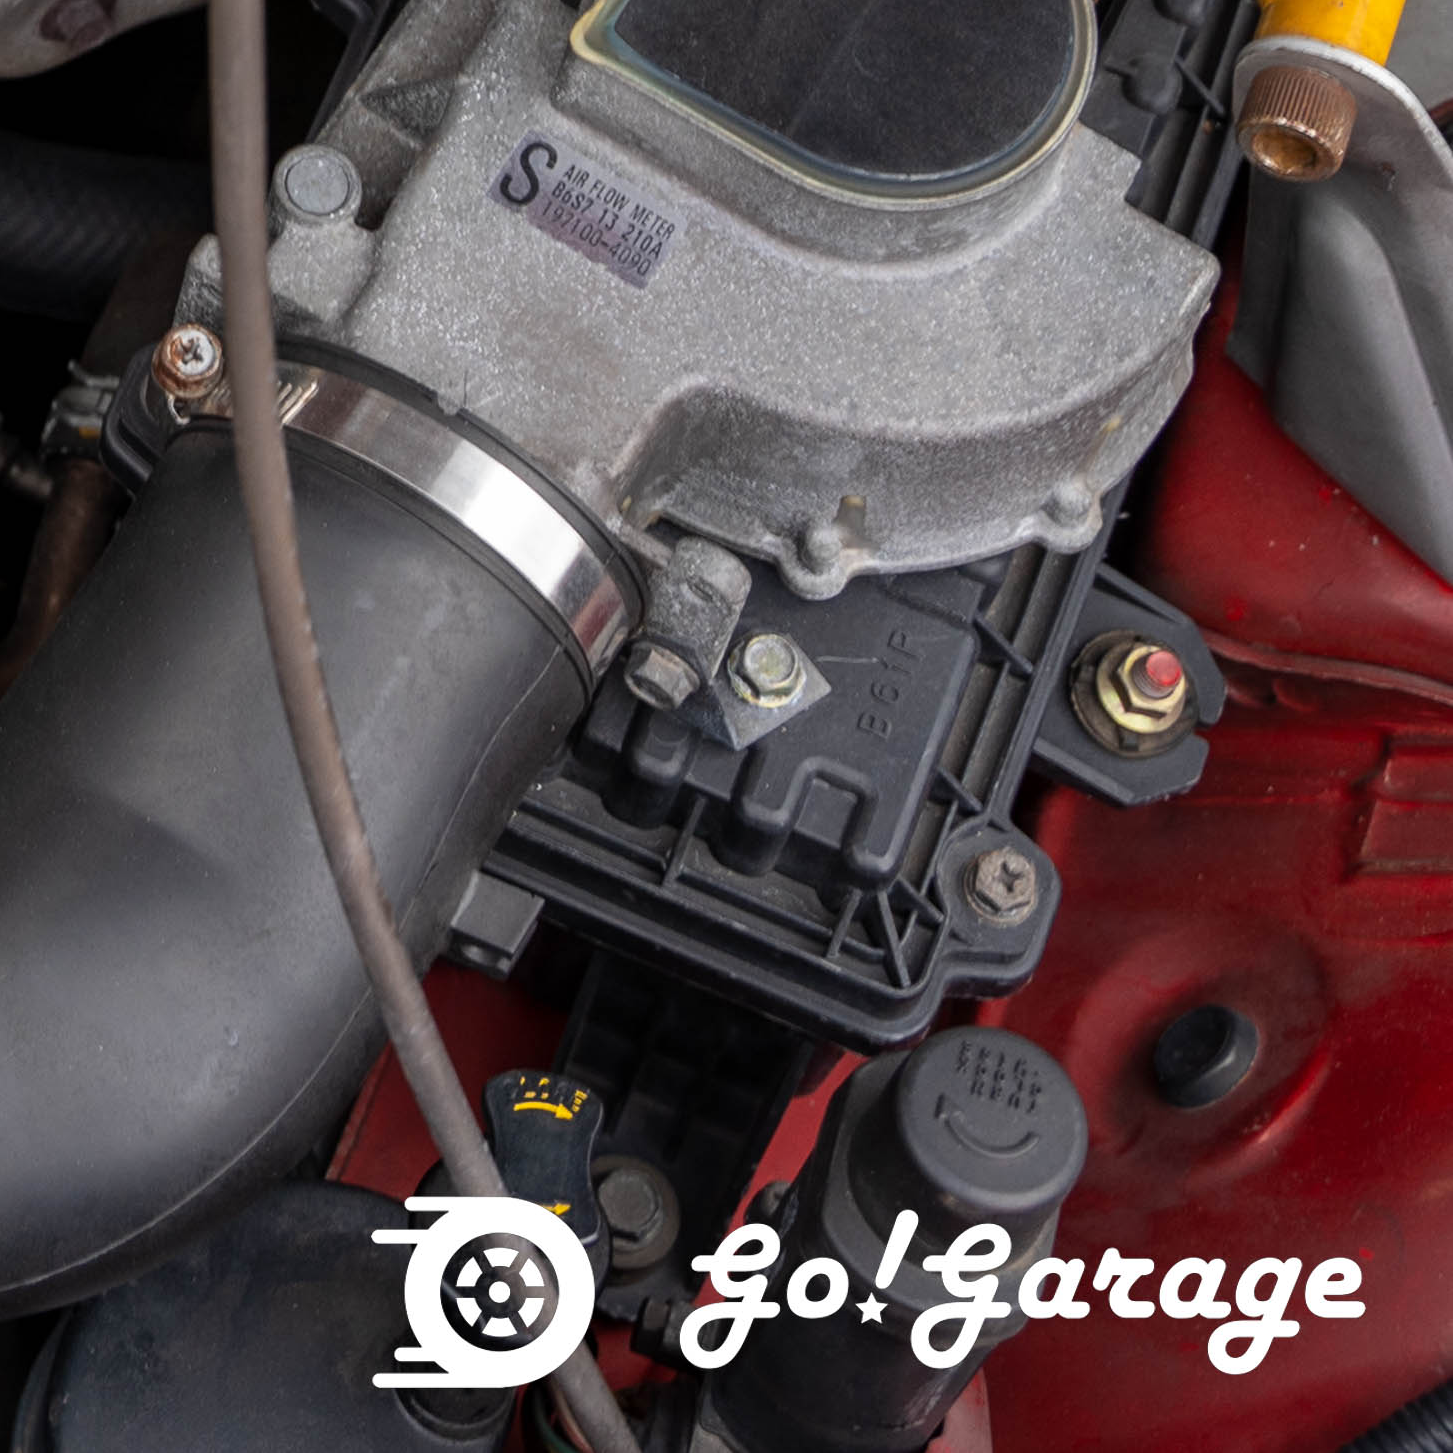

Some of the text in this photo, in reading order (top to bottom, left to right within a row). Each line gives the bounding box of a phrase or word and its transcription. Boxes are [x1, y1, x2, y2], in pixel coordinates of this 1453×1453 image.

[499, 142, 558, 207] S
[562, 164, 676, 241] AIR FLOW METER
[541, 200, 652, 277] 197100-4090
[551, 181, 664, 260] B6S7 13 210A
